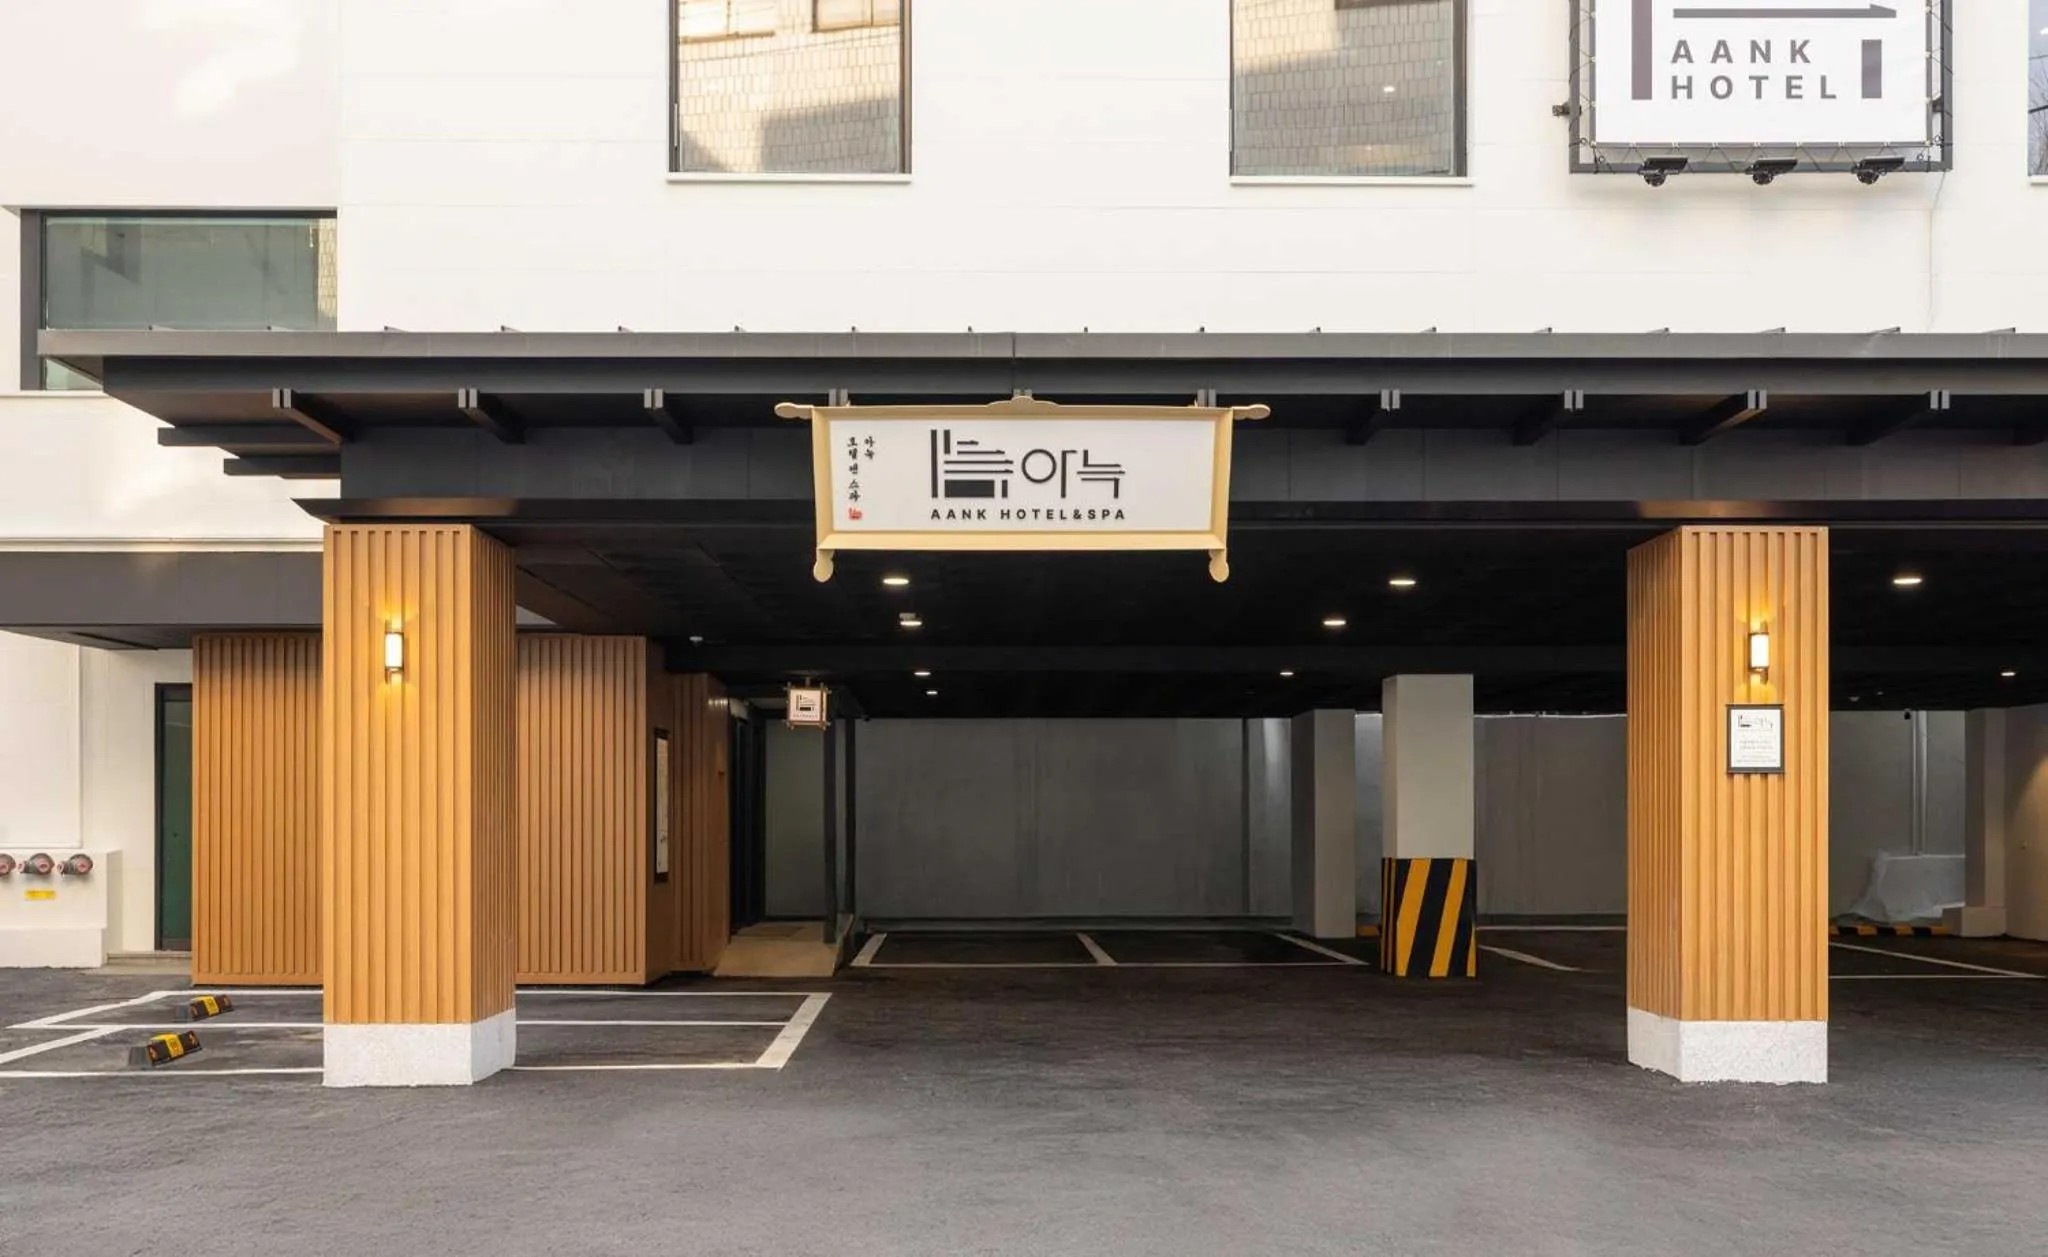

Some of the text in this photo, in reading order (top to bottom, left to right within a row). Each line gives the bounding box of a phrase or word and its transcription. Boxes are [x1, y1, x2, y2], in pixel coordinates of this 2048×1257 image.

[1670, 39, 1811, 64] AANK
[1671, 74, 1837, 100] HOTEL
[930, 508, 1126, 521] AANK HOTEL&SPA
